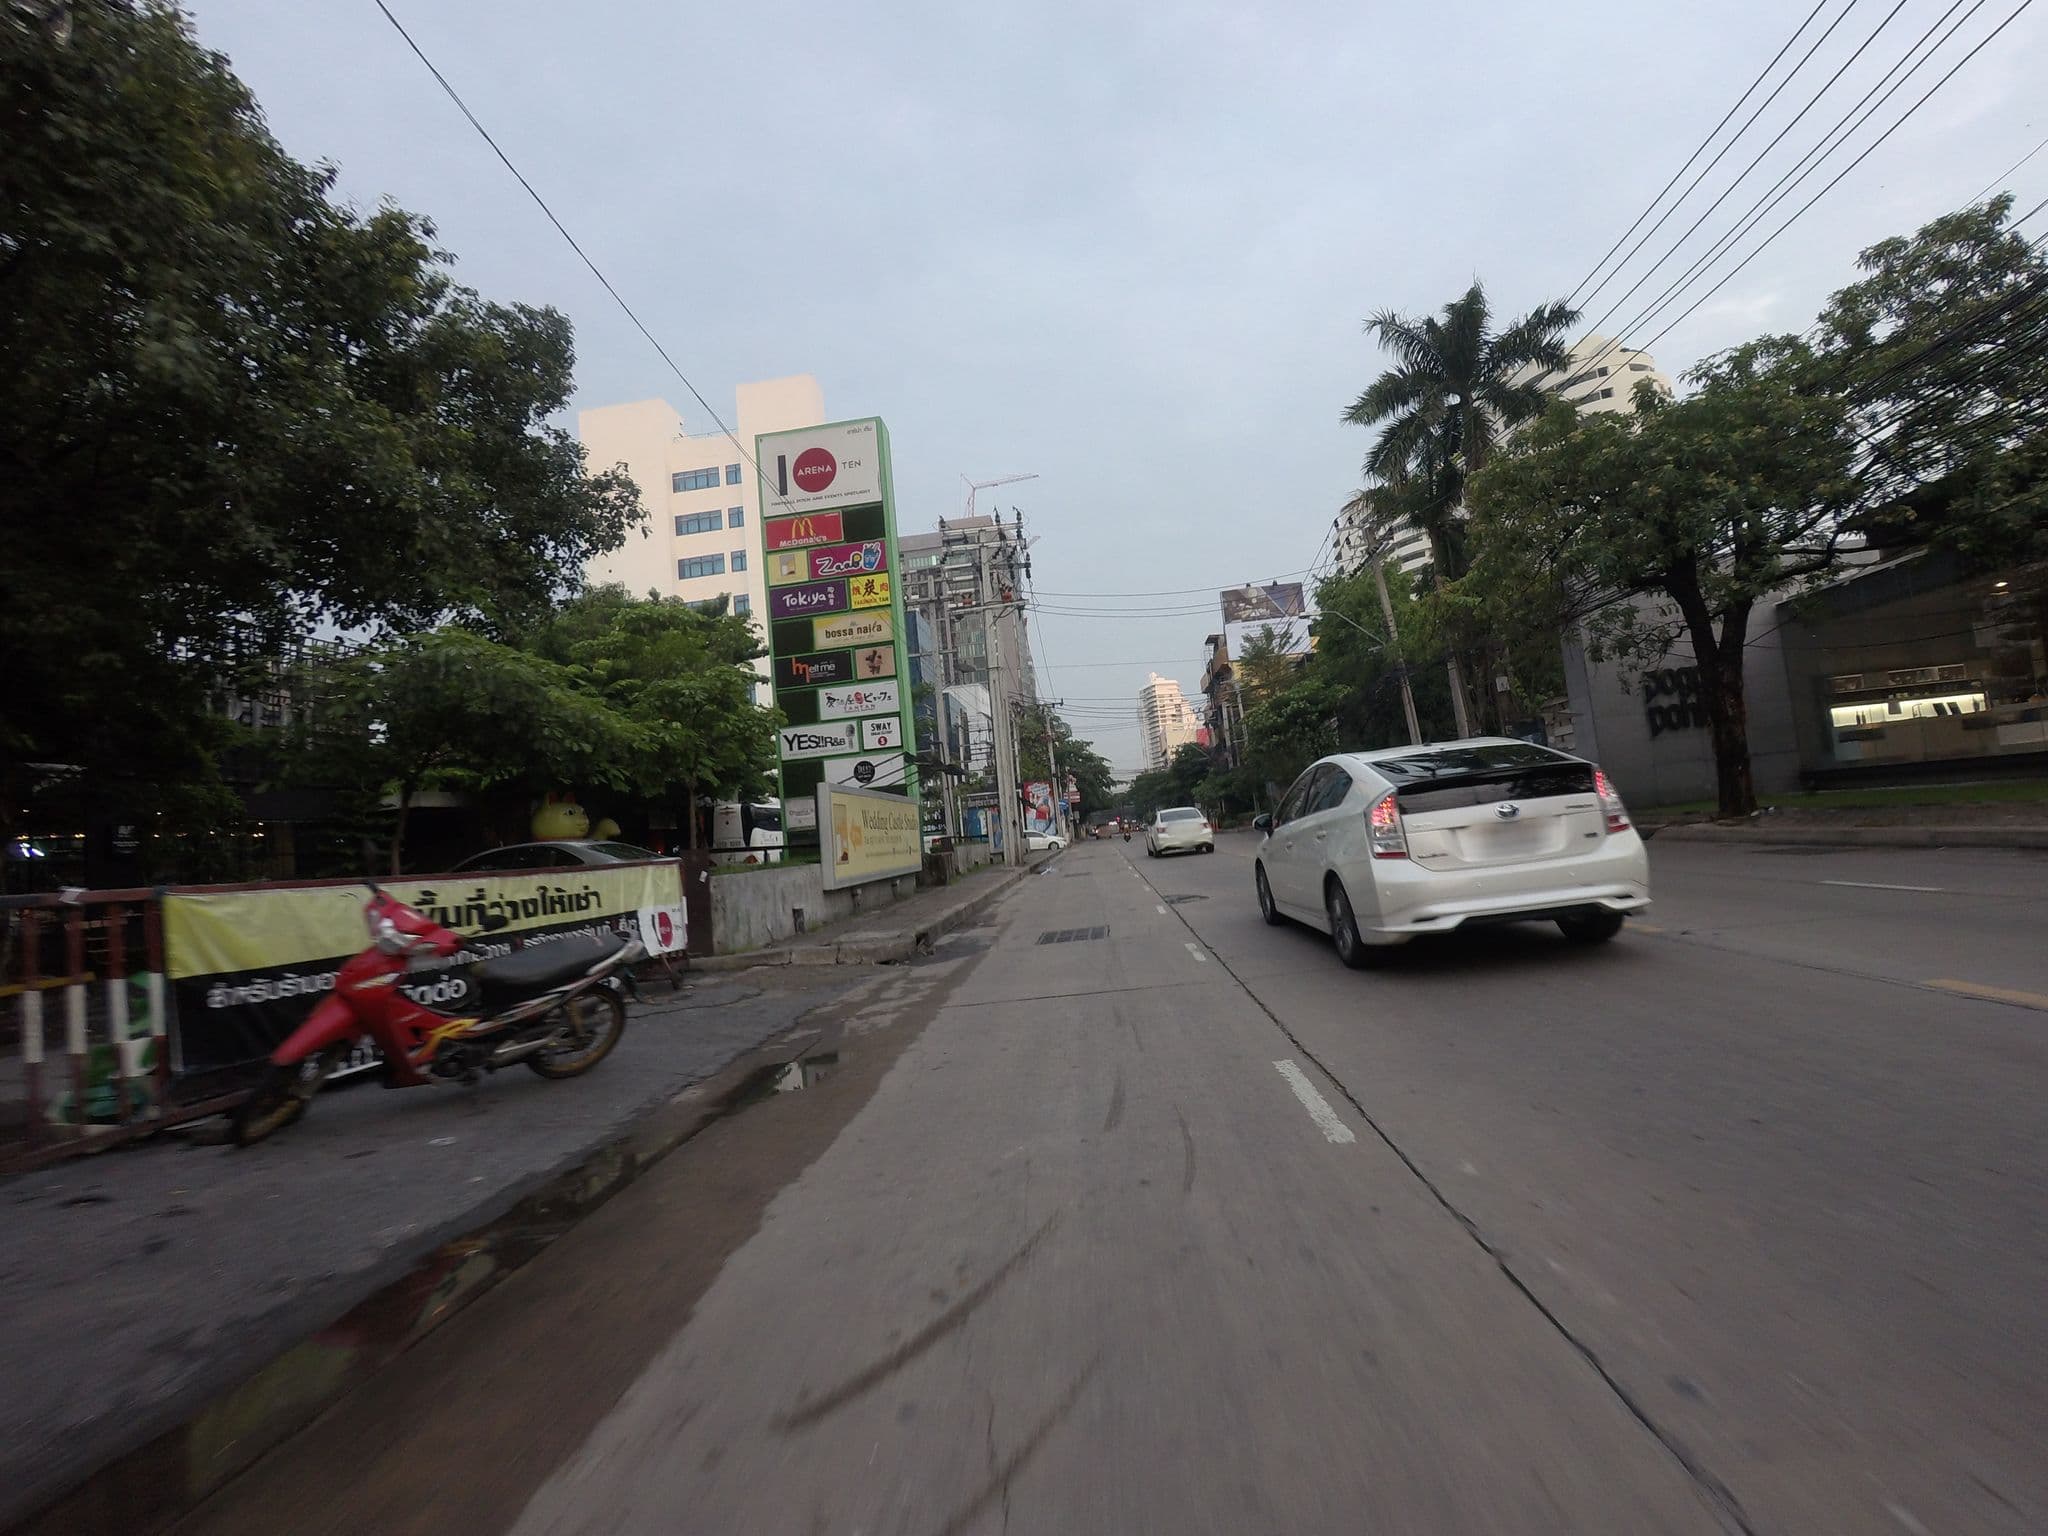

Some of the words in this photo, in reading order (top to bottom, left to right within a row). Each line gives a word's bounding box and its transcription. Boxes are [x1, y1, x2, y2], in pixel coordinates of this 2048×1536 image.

[797, 464, 833, 477] ARENA
[841, 459, 862, 470] TEN
[825, 626, 854, 639] bossa
[870, 722, 891, 732] SWAY
